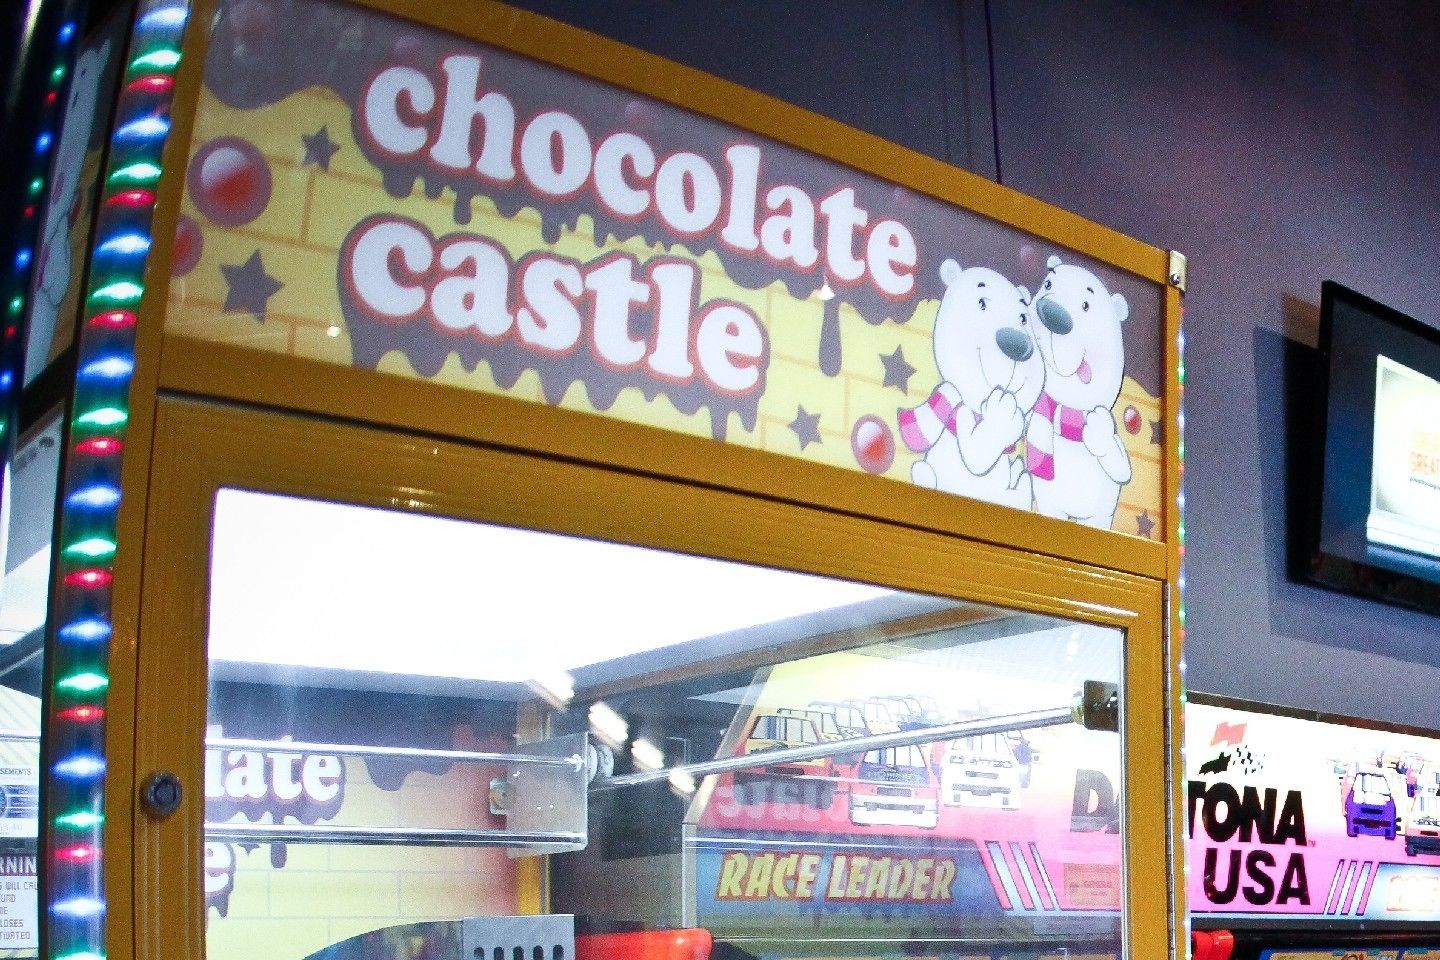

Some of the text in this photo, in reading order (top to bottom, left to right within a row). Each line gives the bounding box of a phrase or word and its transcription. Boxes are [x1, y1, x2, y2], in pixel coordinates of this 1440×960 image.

[362, 52, 919, 298] chocolate
[349, 219, 766, 394] castle
[718, 851, 957, 901] RACE LEADER
[1202, 847, 1311, 906] USA
